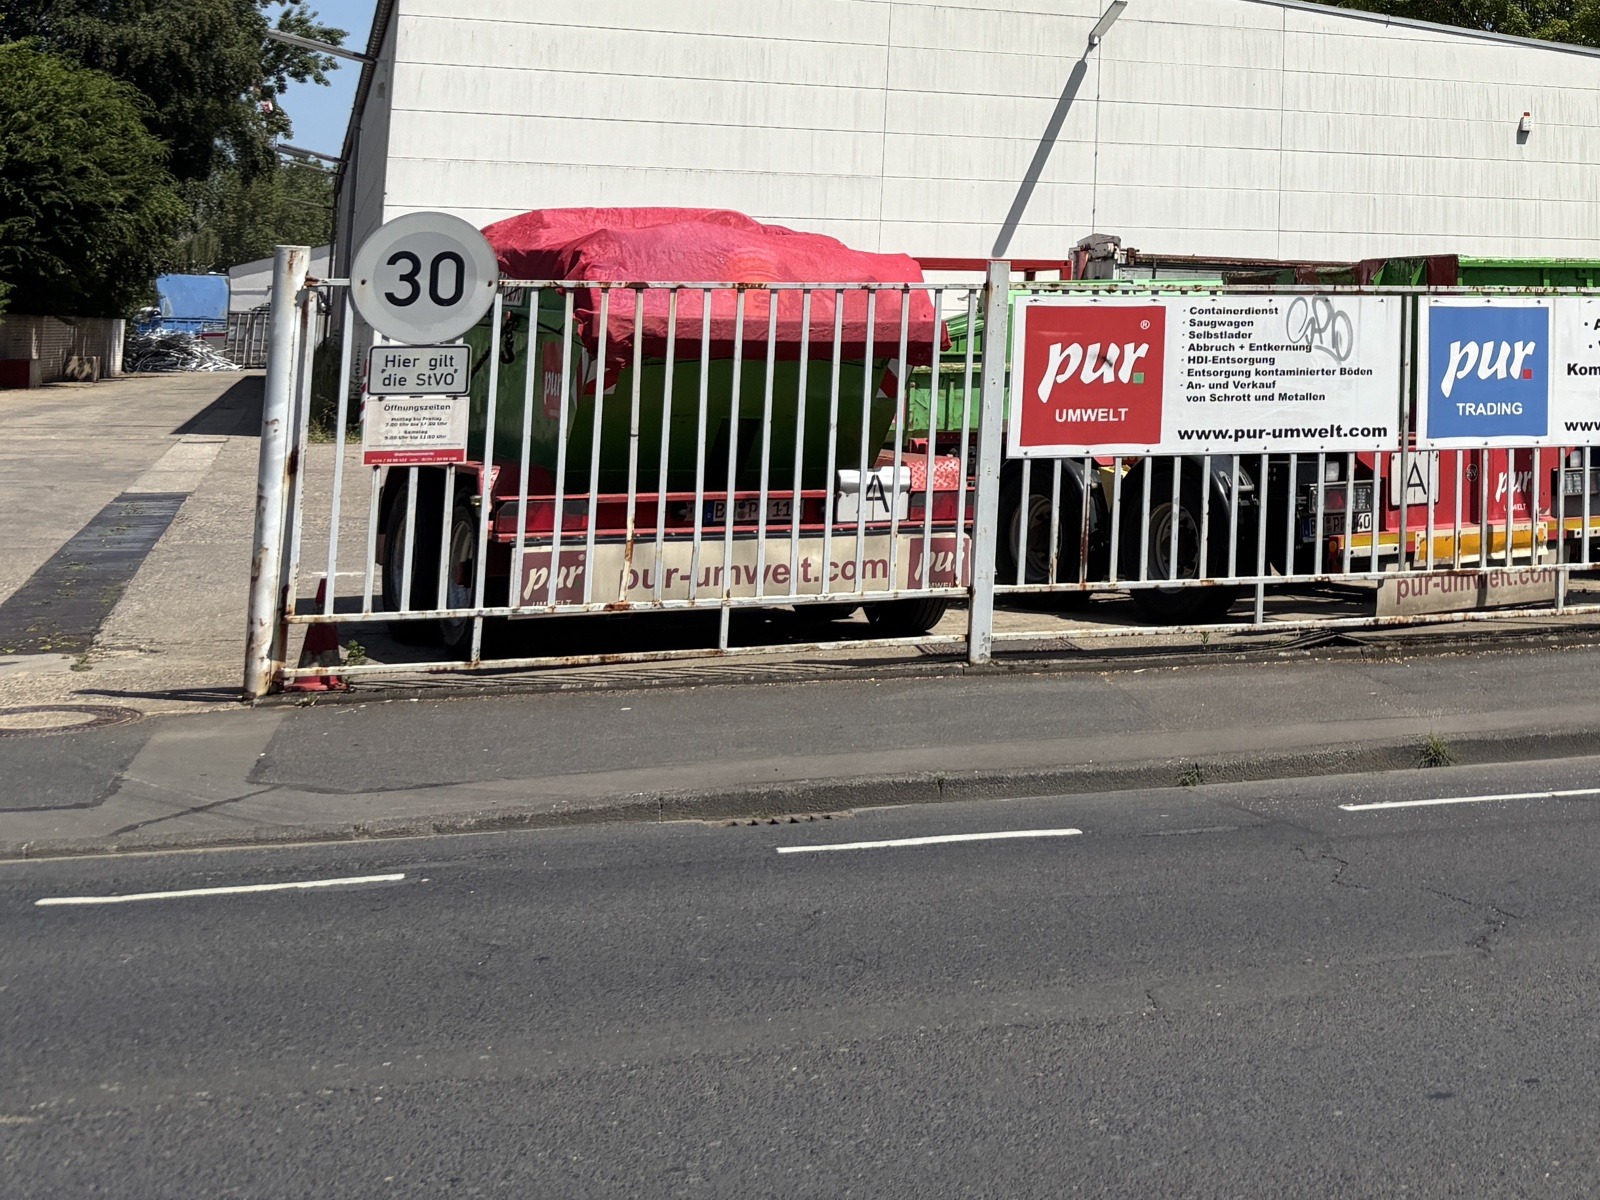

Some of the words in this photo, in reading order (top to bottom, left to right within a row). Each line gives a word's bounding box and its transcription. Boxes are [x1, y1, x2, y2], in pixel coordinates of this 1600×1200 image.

[384, 250, 465, 307] 30
[1189, 306, 1279, 316] Containerdienst
[1189, 318, 1254, 329] Saugwagen
[1188, 330, 1253, 340] Selbstlader
[1188, 343, 1235, 352] Abbruch
[1249, 343, 1312, 353] Entkernung
[384, 354, 420, 368] Hier
[429, 354, 454, 371] gilt
[1187, 355, 1276, 366] HDI-Entsorgung
[1187, 368, 1251, 379] Entsorgung
[1255, 367, 1337, 377] kontaminierter
[1340, 366, 1373, 376] Böden
[382, 373, 407, 387] die
[416, 372, 455, 386] StVO
[1186, 381, 1205, 390] An-
[1208, 381, 1229, 389] und
[1232, 380, 1276, 389] Verkauf
[1186, 394, 1206, 403] von
[1209, 393, 1251, 402] Schrott
[1254, 393, 1275, 402] und
[1278, 392, 1325, 401] Metallen
[384, 404, 451, 412] Öffnungszeiten
[1456, 402, 1523, 416] TRADING
[1055, 408, 1129, 422] UMWELT
[1177, 424, 1388, 442] www.pur-umwelt.com
[1404, 461, 1427, 495] A
[858, 475, 890, 513] A
[620, 557, 888, 593] pur-umwet.com
